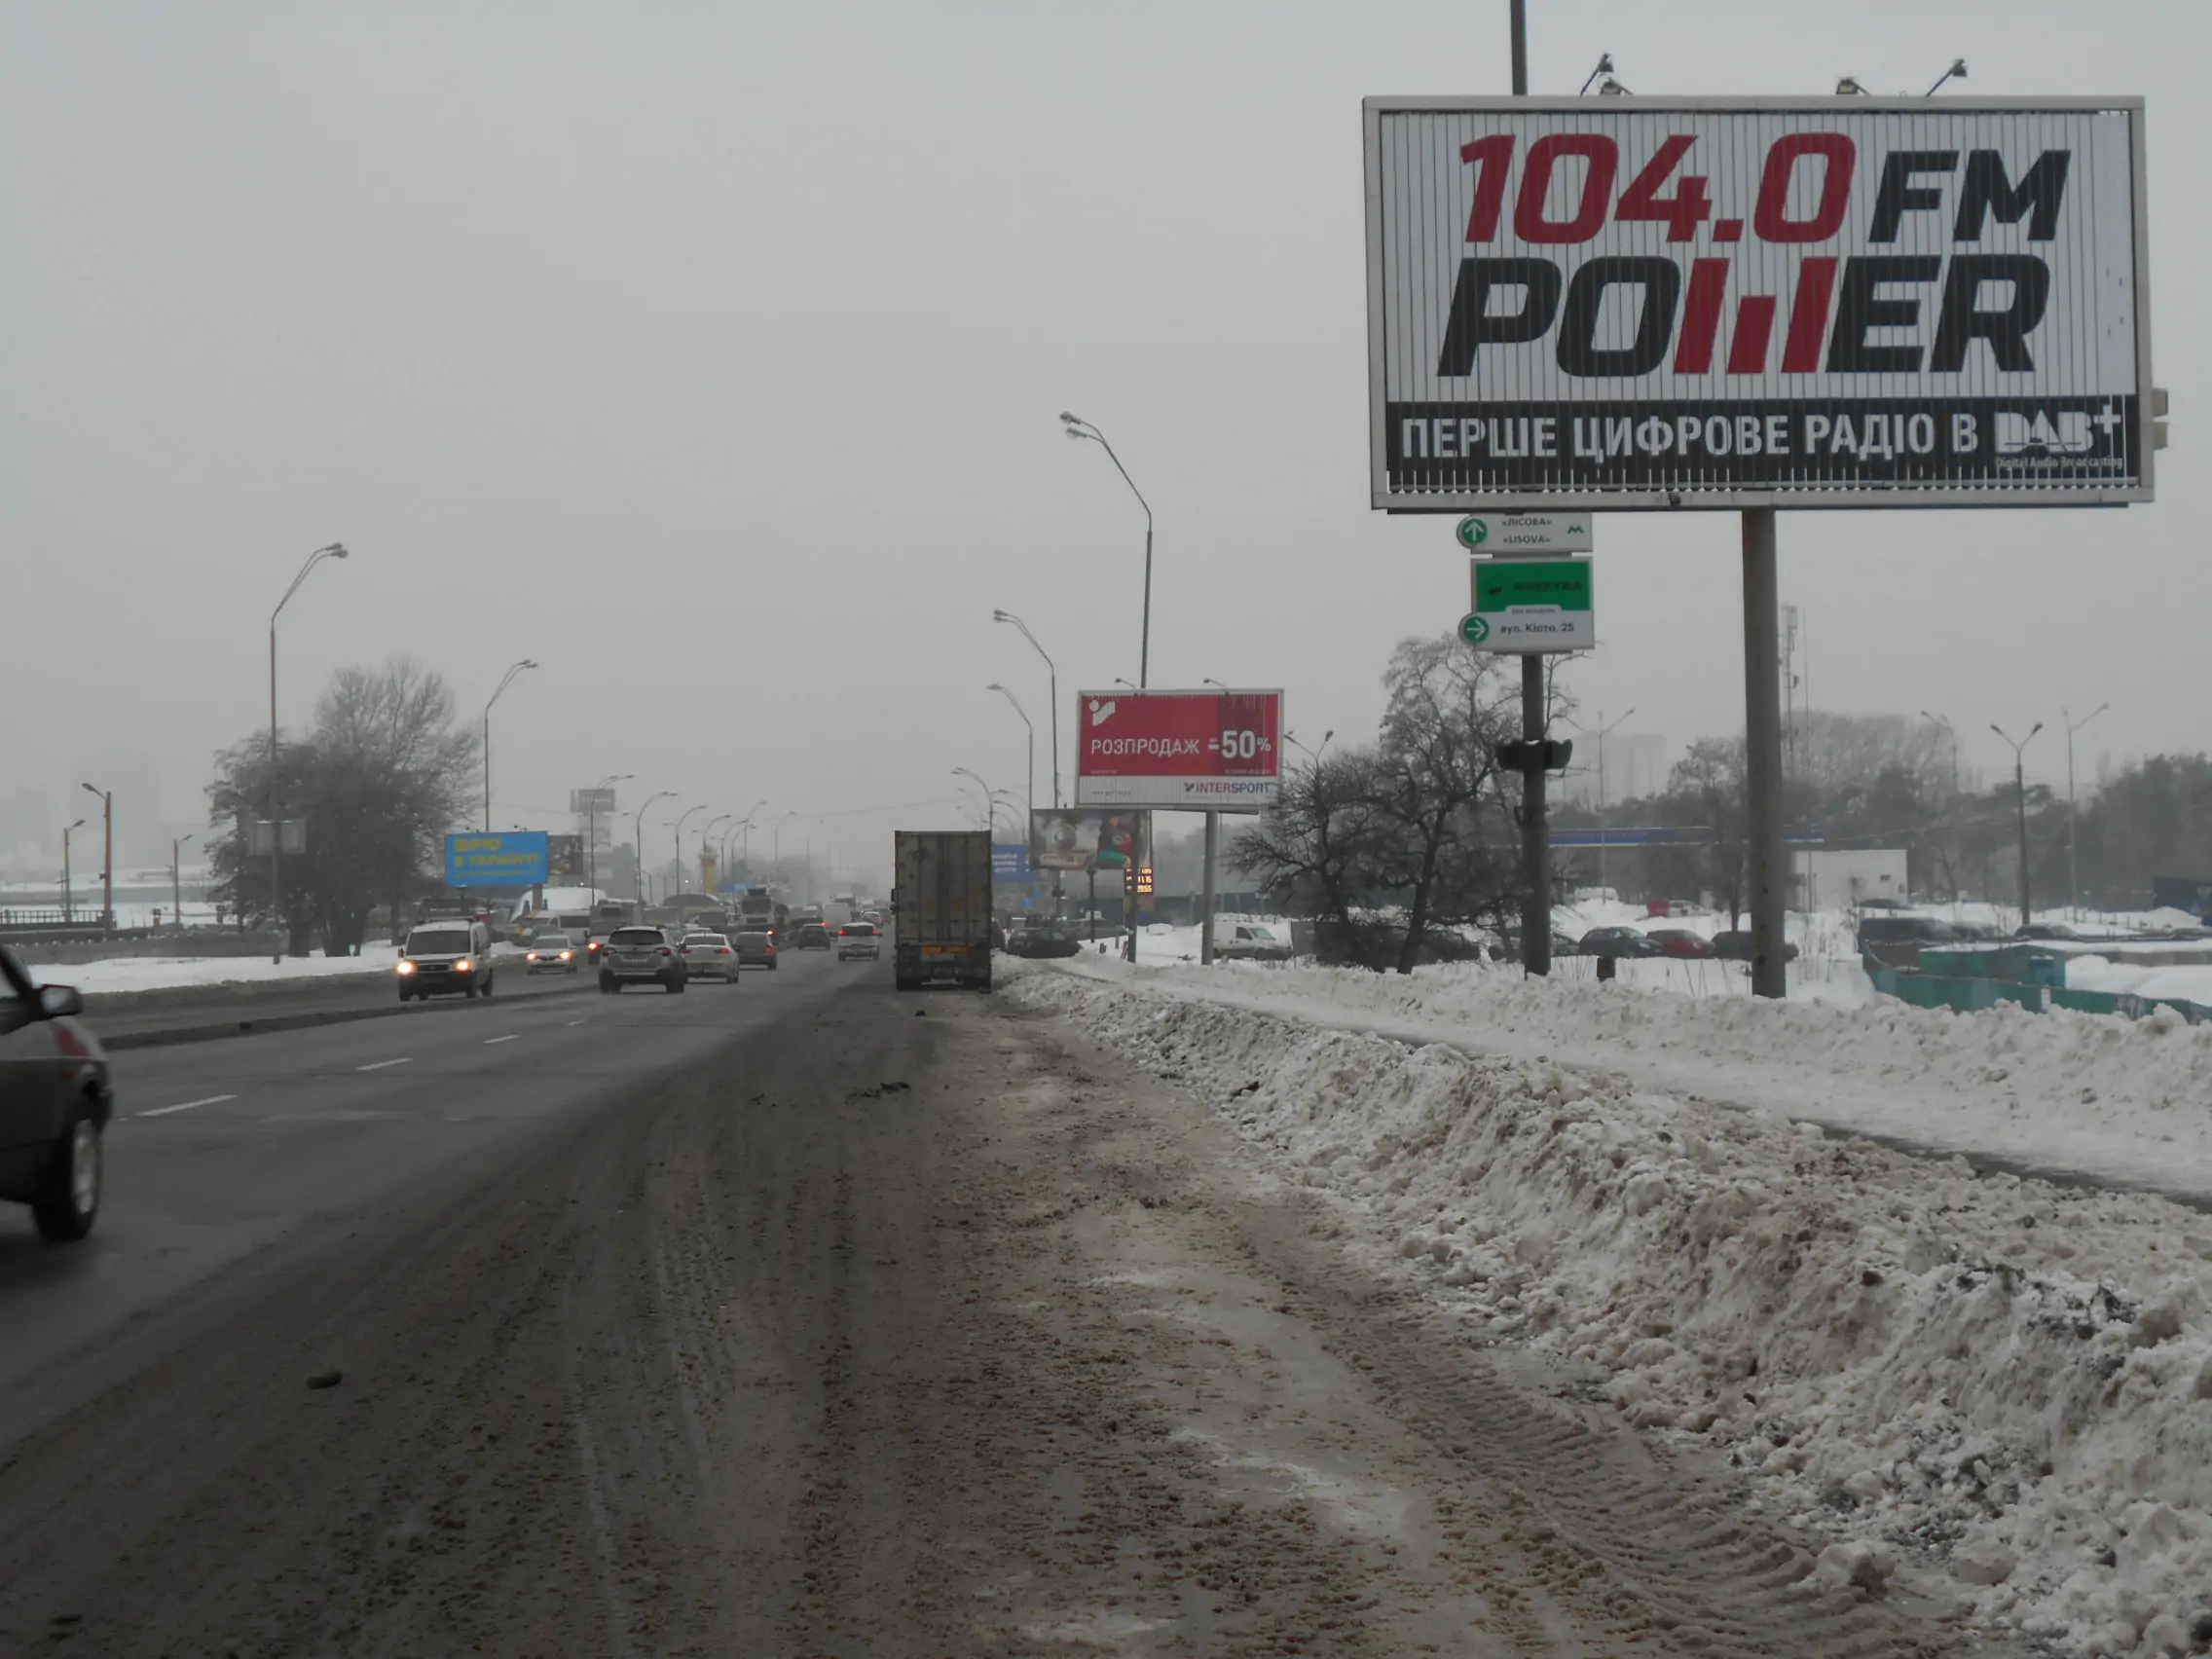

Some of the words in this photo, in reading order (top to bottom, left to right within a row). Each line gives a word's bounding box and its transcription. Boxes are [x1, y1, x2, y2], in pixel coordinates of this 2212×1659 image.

[1460, 132, 1856, 243] 104.0
[1868, 150, 2071, 242] FM
[1437, 254, 2050, 377] POWER
[1402, 417, 1557, 459] ПЕРШЕ
[1573, 416, 1789, 463] ЦИФРОВЕ
[1804, 414, 1936, 461] РАДІО
[1951, 413, 1978, 454] В
[1994, 404, 2121, 454] DAB+
[1996, 456, 2027, 469] Digital
[2030, 456, 2058, 468] Audio
[2060, 455, 2123, 468] Broadcasting
[1500, 625, 1523, 635] вул.
[1561, 622, 1574, 632] 25
[1091, 738, 1199, 756] РОЗПРОДАЖ
[1196, 782, 1270, 794] INTERSPORT
